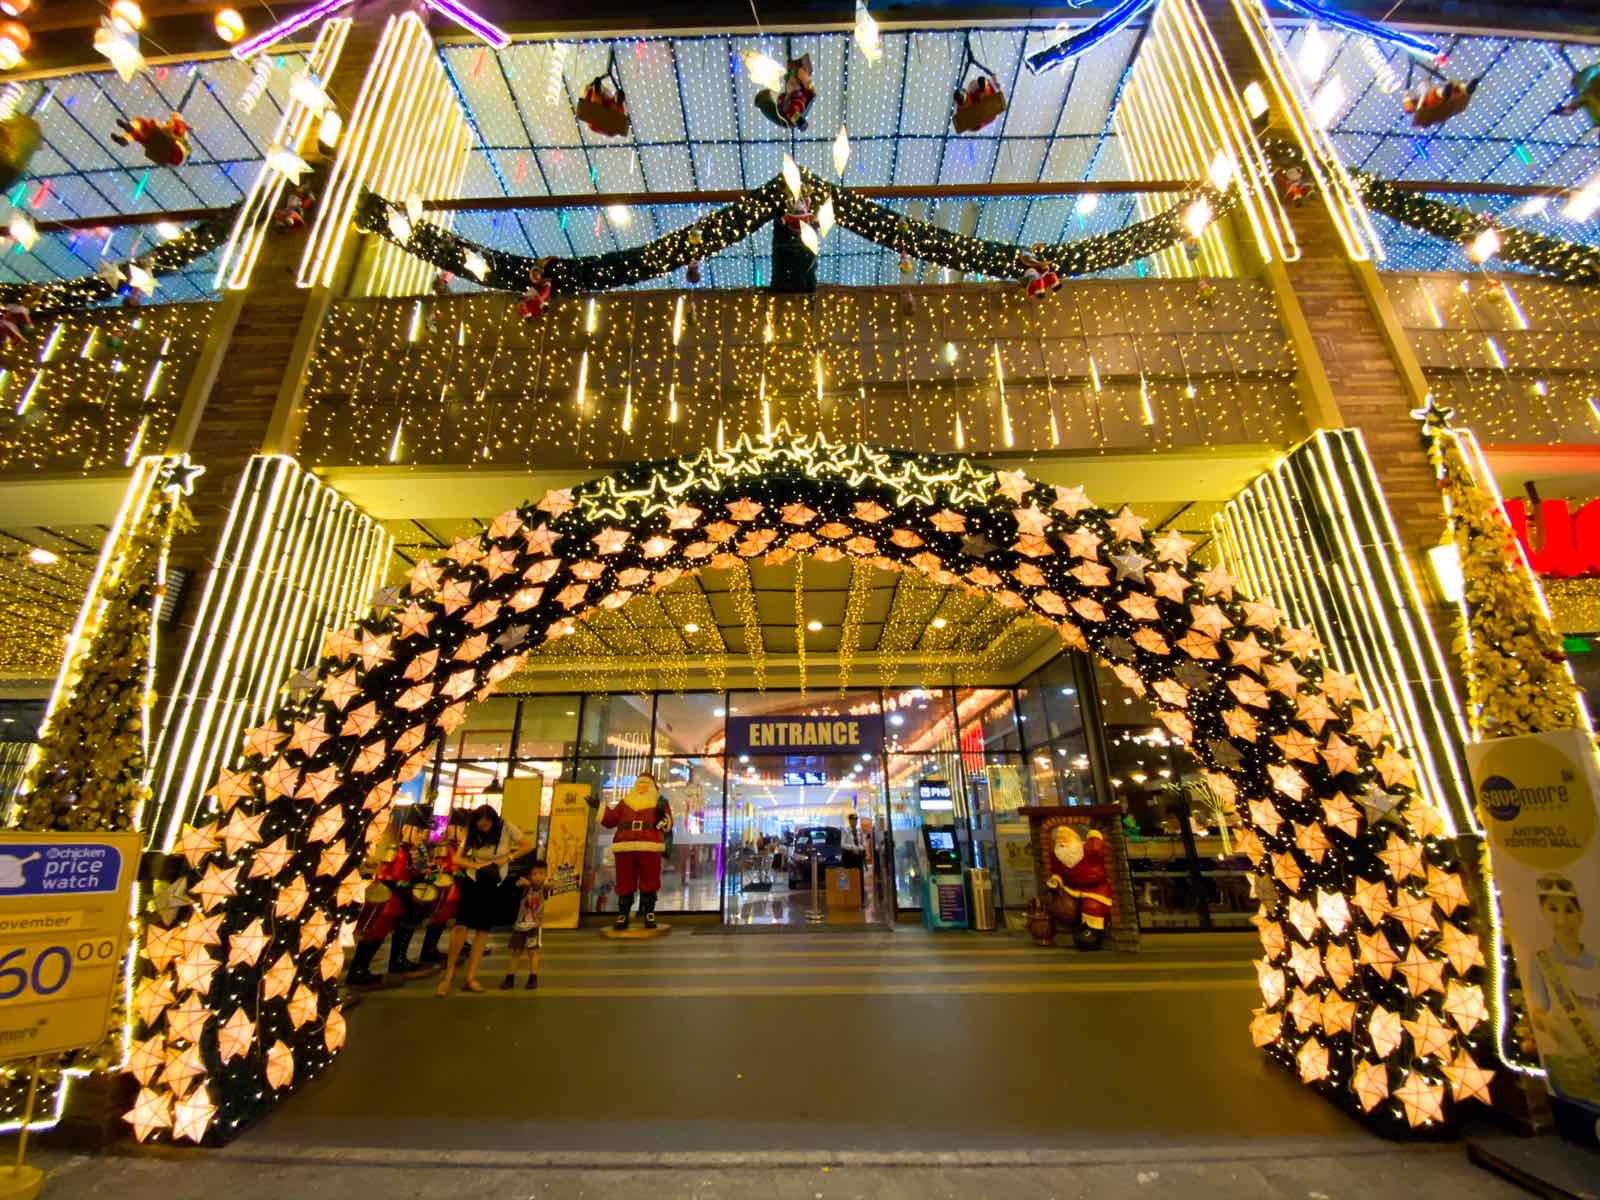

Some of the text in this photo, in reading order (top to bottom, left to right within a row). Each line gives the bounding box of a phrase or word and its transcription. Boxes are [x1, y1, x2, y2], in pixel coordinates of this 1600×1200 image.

[749, 721, 860, 746] ENTRANCE
[44, 858, 103, 878] price
[42, 875, 99, 889] watch
